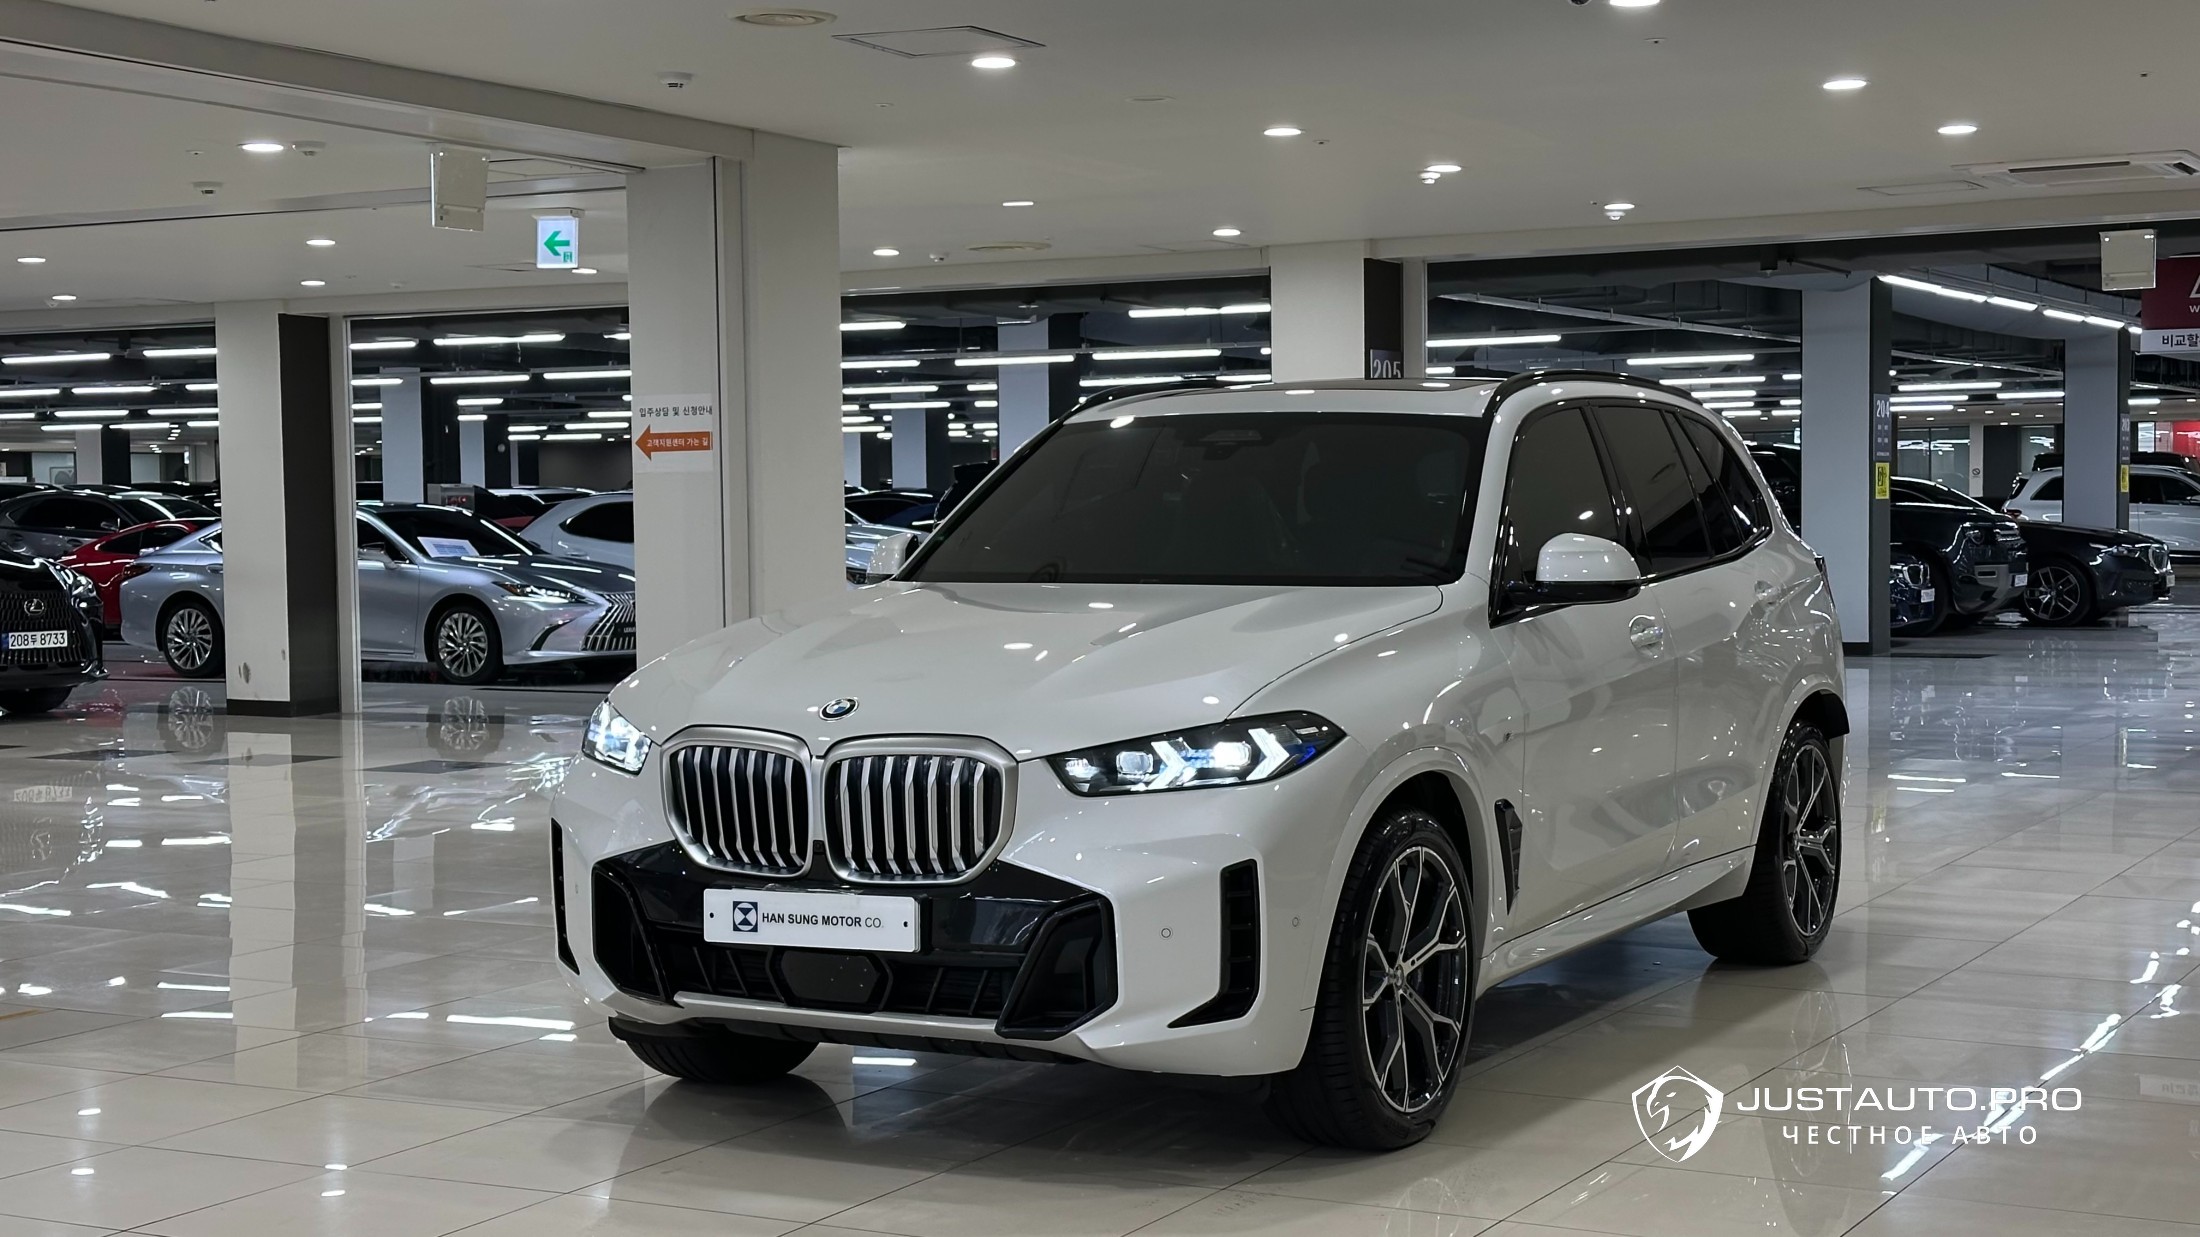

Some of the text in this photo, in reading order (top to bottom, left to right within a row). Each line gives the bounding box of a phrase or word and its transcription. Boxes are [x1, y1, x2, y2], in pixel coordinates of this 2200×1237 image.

[2162, 333, 2200, 347] 비교할
[1373, 359, 1401, 378] 205
[639, 405, 712, 417] 입주상담 및 신청안내
[1876, 400, 1889, 418] 204
[647, 438, 685, 447] 고객지원센터
[686, 437, 699, 446] 가는
[10, 632, 65, 647] 208두 8733
[762, 913, 784, 924] HAN
[788, 914, 818, 925] SUNG
[822, 916, 861, 927] MOTOR
